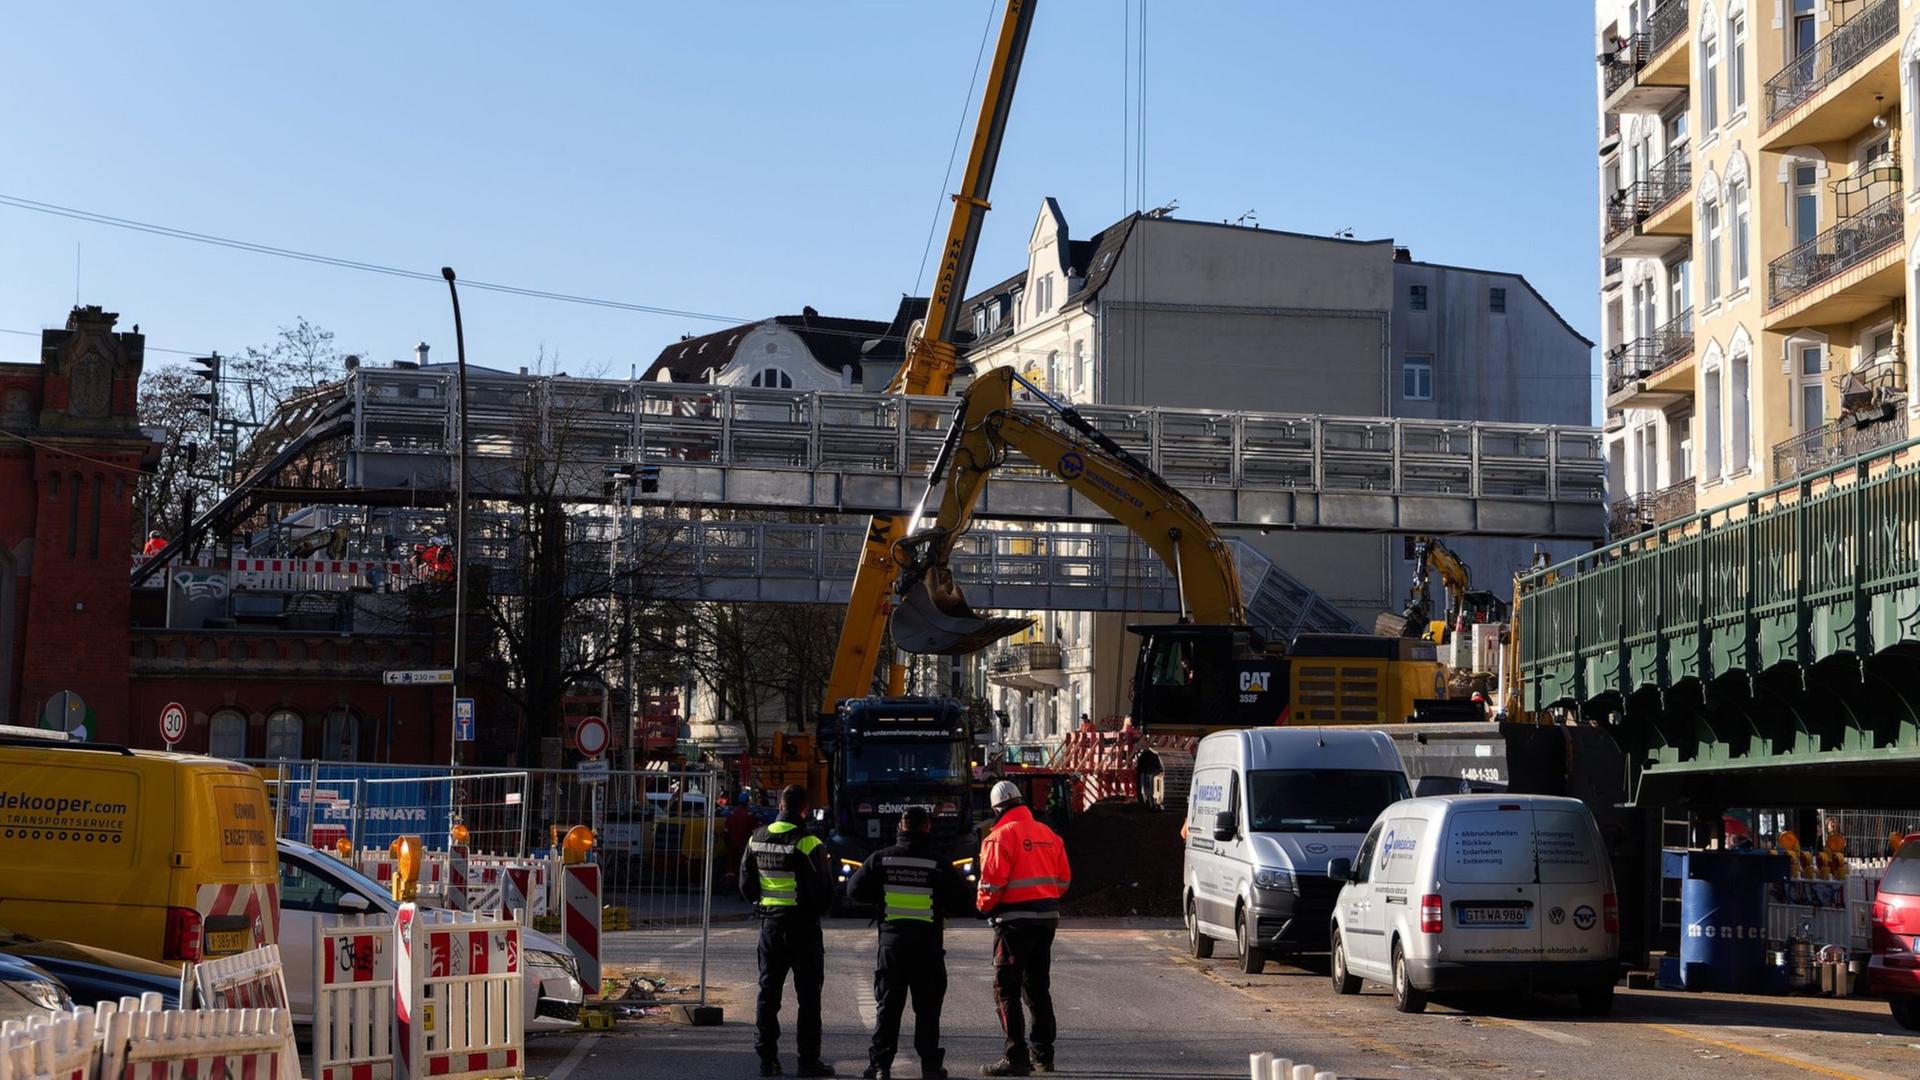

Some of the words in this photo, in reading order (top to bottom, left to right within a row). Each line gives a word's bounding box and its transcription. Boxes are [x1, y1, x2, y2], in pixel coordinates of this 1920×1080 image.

[937, 238, 962, 305] KNAACK
[1240, 671, 1271, 692] CAT
[1240, 694, 1259, 704] 352F
[166, 714, 180, 732] 30
[1466, 910, 1481, 921] GT
[1487, 910, 1501, 921] WA
[1503, 910, 1523, 921] 986
